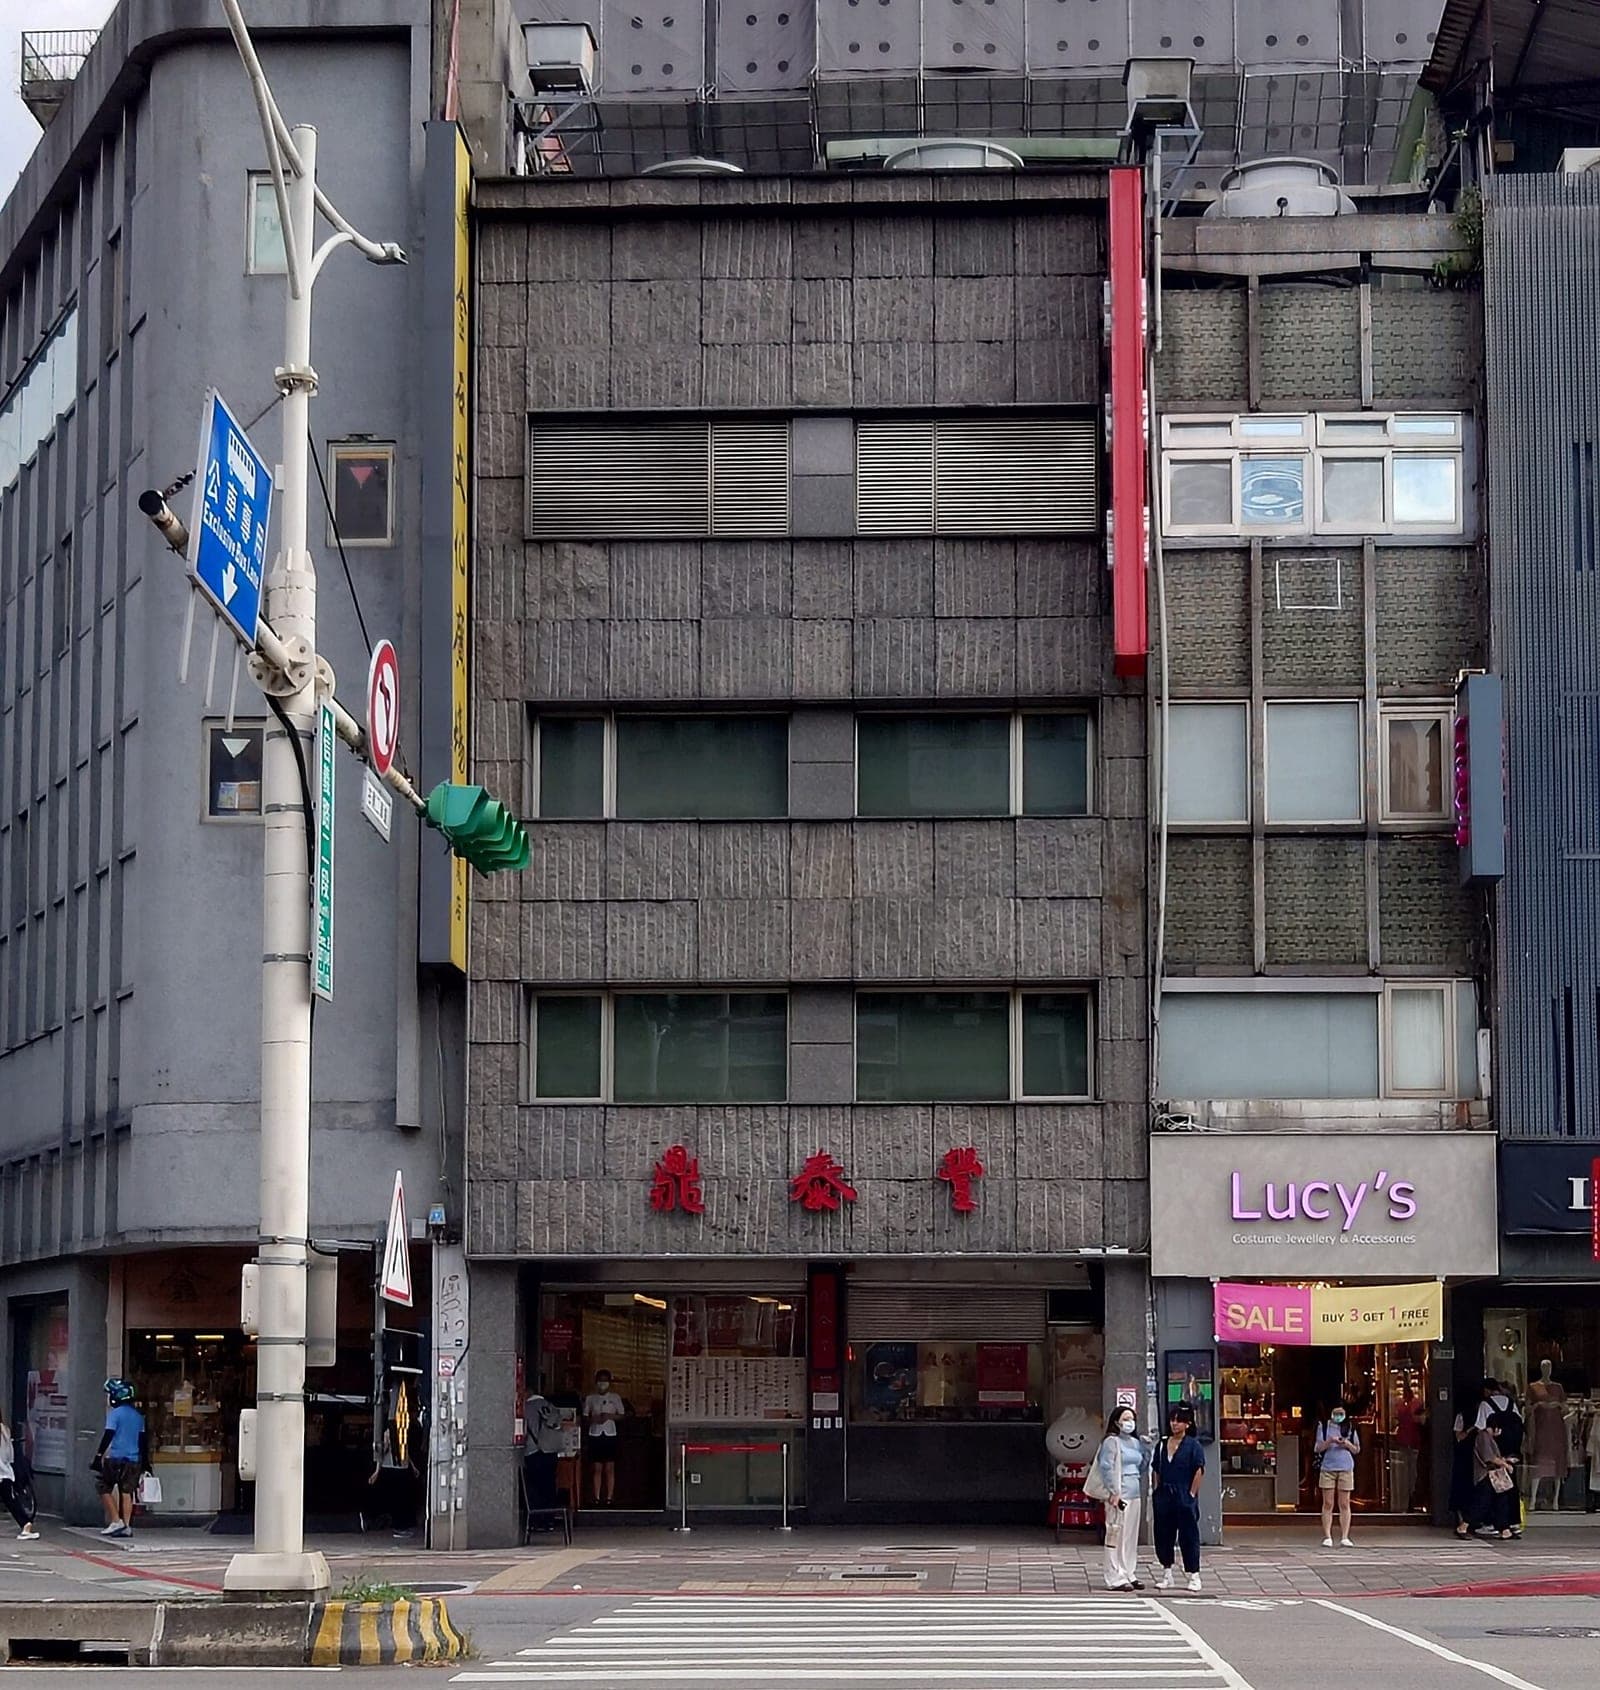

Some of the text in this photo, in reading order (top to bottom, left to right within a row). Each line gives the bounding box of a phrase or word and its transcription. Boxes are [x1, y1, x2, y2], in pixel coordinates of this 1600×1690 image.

[206, 458, 265, 566] 公車專用
[203, 500, 260, 591] Exclusive Bus Lane
[650, 1144, 983, 1215] 鼎泰豐
[1231, 1170, 1418, 1233] Lucy's
[1232, 1233, 1417, 1246] Costume Jewellery & Accessories
[1227, 1303, 1304, 1333] SALE
[1322, 1306, 1430, 1323] BUY 3 GET 1 FREE
